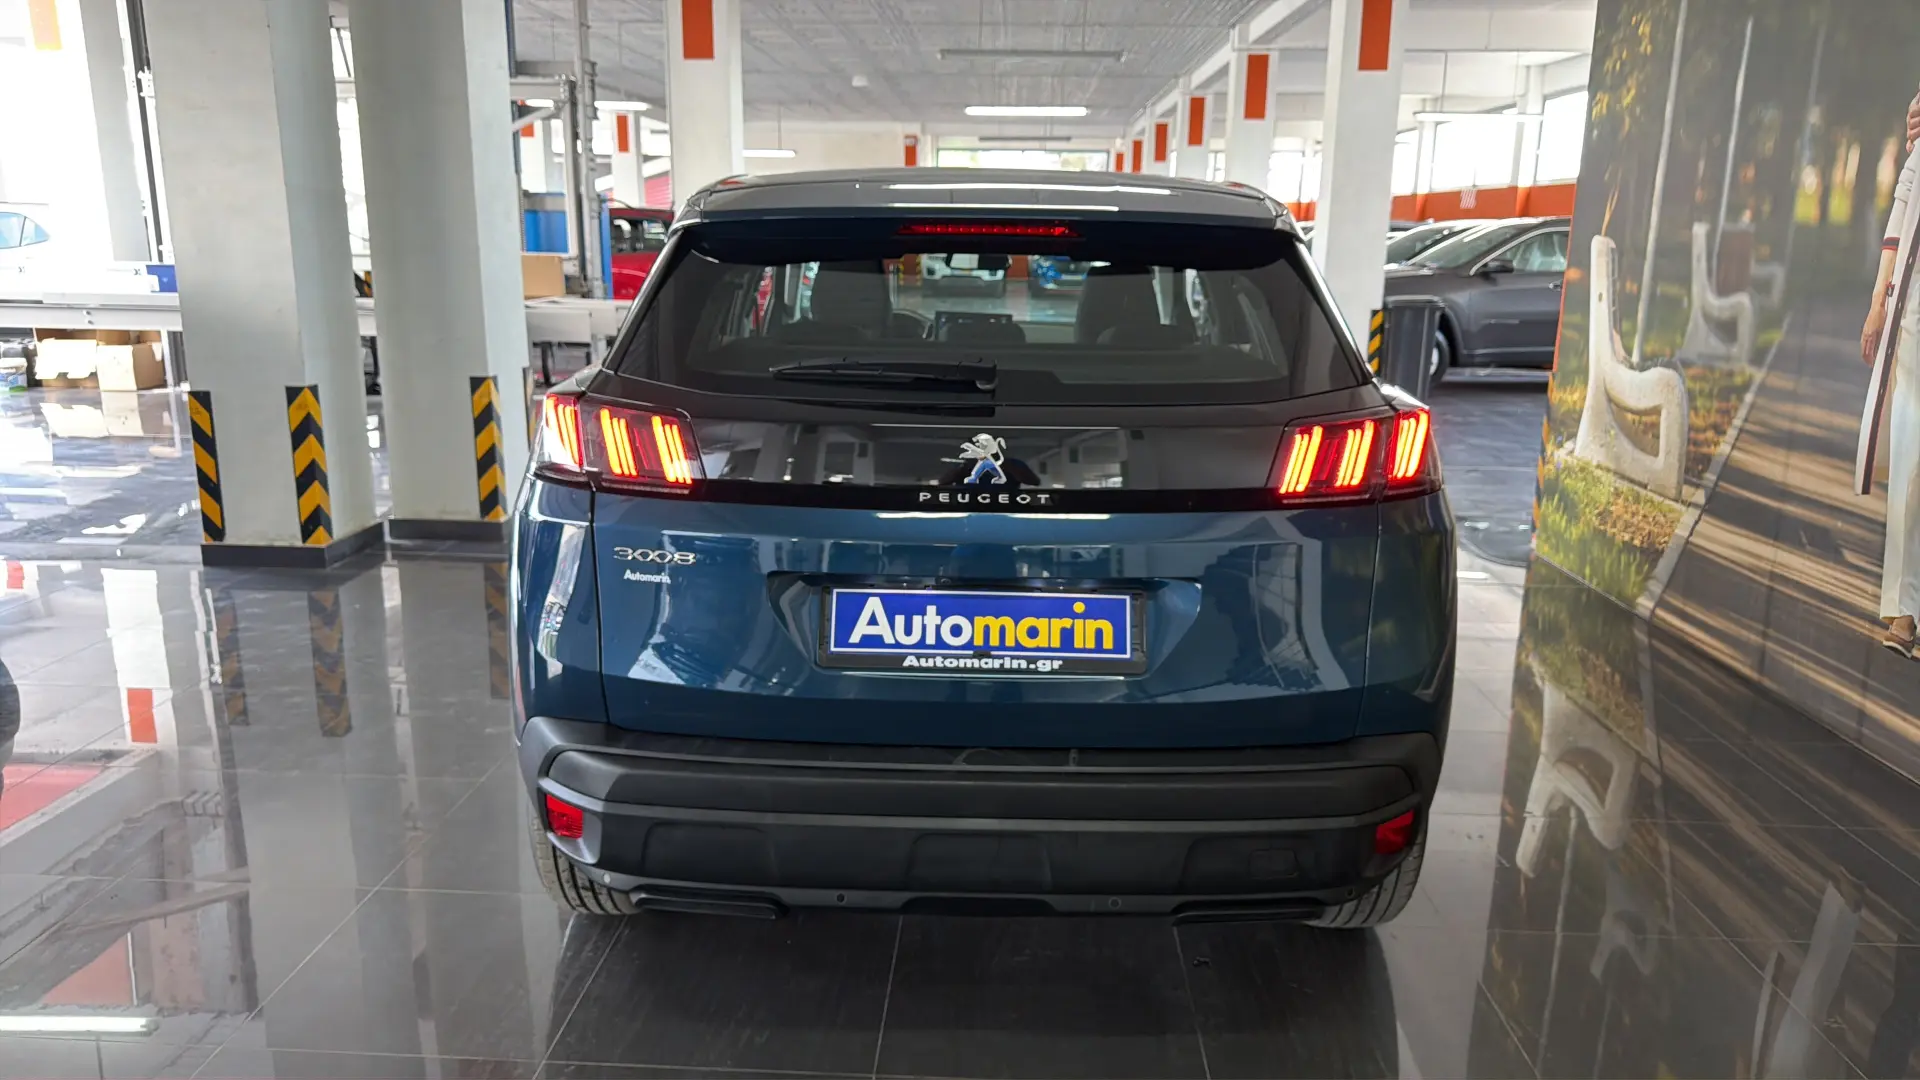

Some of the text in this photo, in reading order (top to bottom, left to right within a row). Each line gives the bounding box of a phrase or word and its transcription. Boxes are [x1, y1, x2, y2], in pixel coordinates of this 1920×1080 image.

[919, 492, 1050, 504] PEUGEOT
[613, 547, 696, 565] 3008
[623, 569, 671, 584] Automarin
[849, 597, 1114, 650] Automarin
[904, 655, 1063, 672] Automarin.gr
